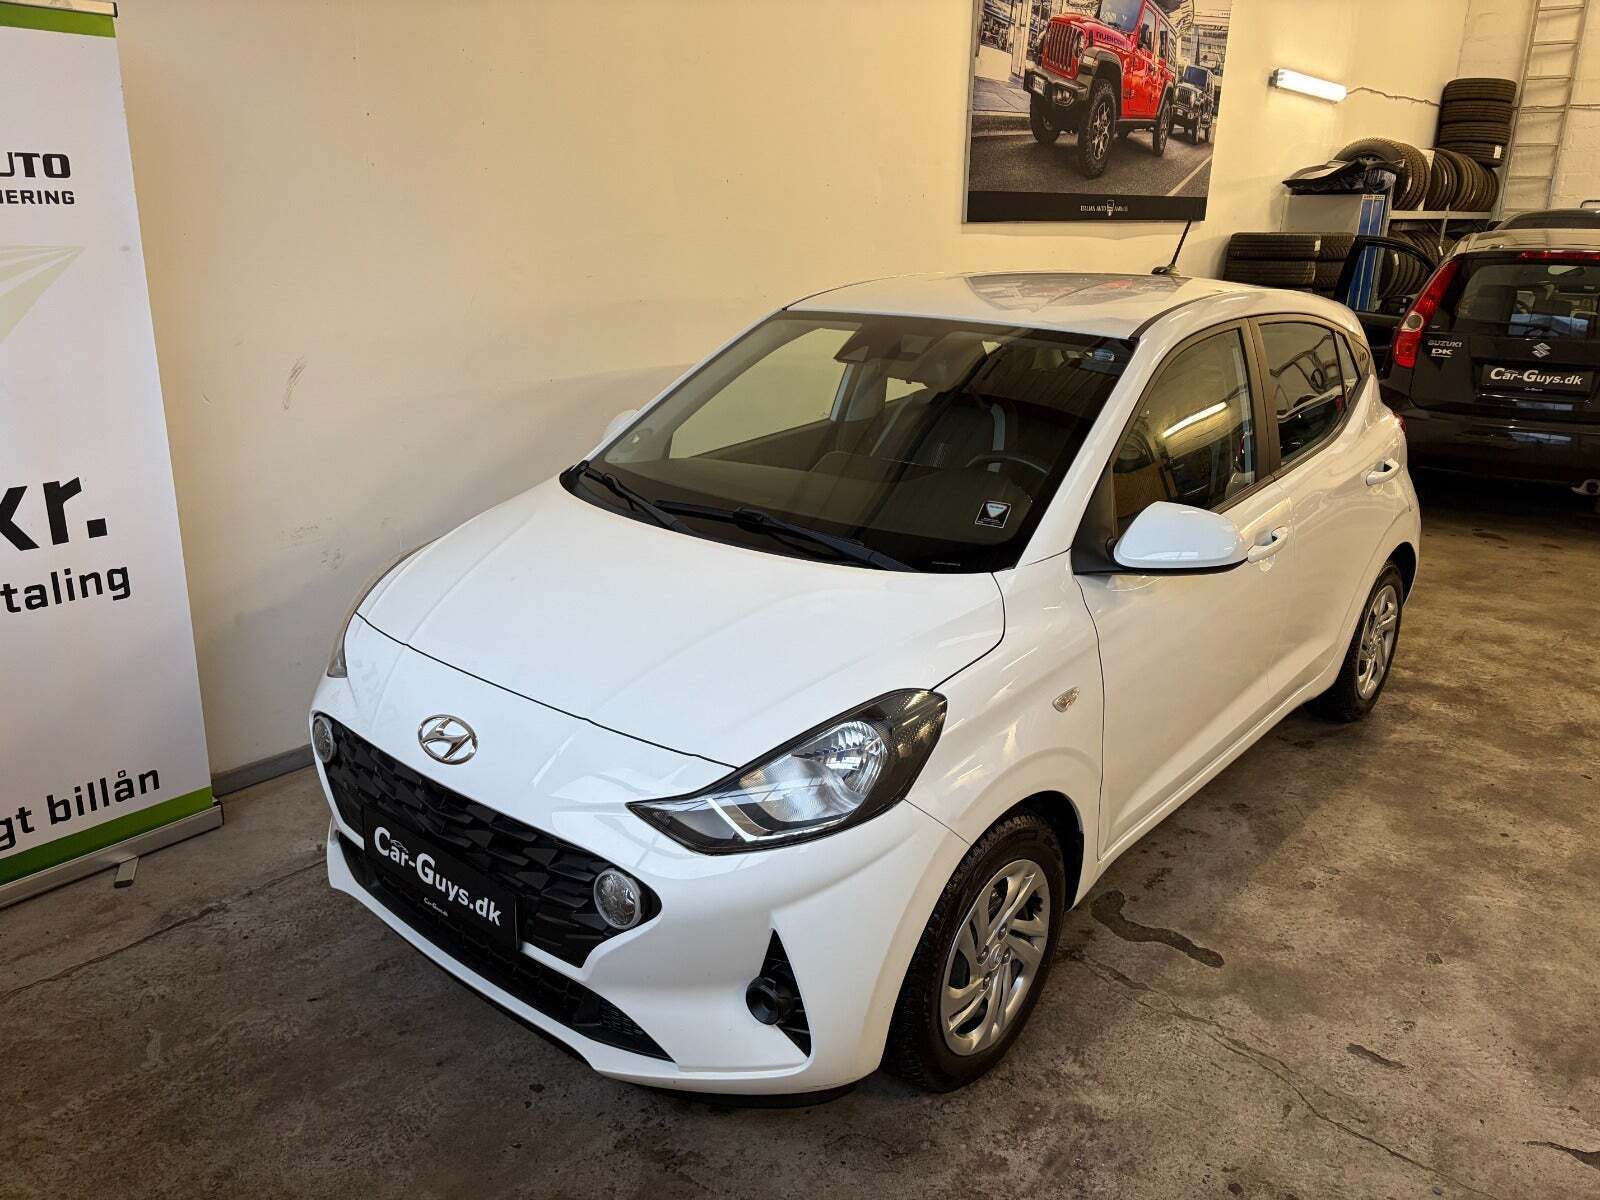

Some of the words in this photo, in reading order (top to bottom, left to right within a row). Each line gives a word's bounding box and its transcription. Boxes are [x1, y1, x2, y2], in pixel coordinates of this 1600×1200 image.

[1428, 339, 1463, 348] SUZUKI
[1490, 367, 1583, 385] Car-Guys.dk
[0, 477, 108, 551] kr.
[0, 566, 131, 613] taling
[46, 769, 160, 825] billån
[374, 826, 502, 926] Car-Guys.dk
